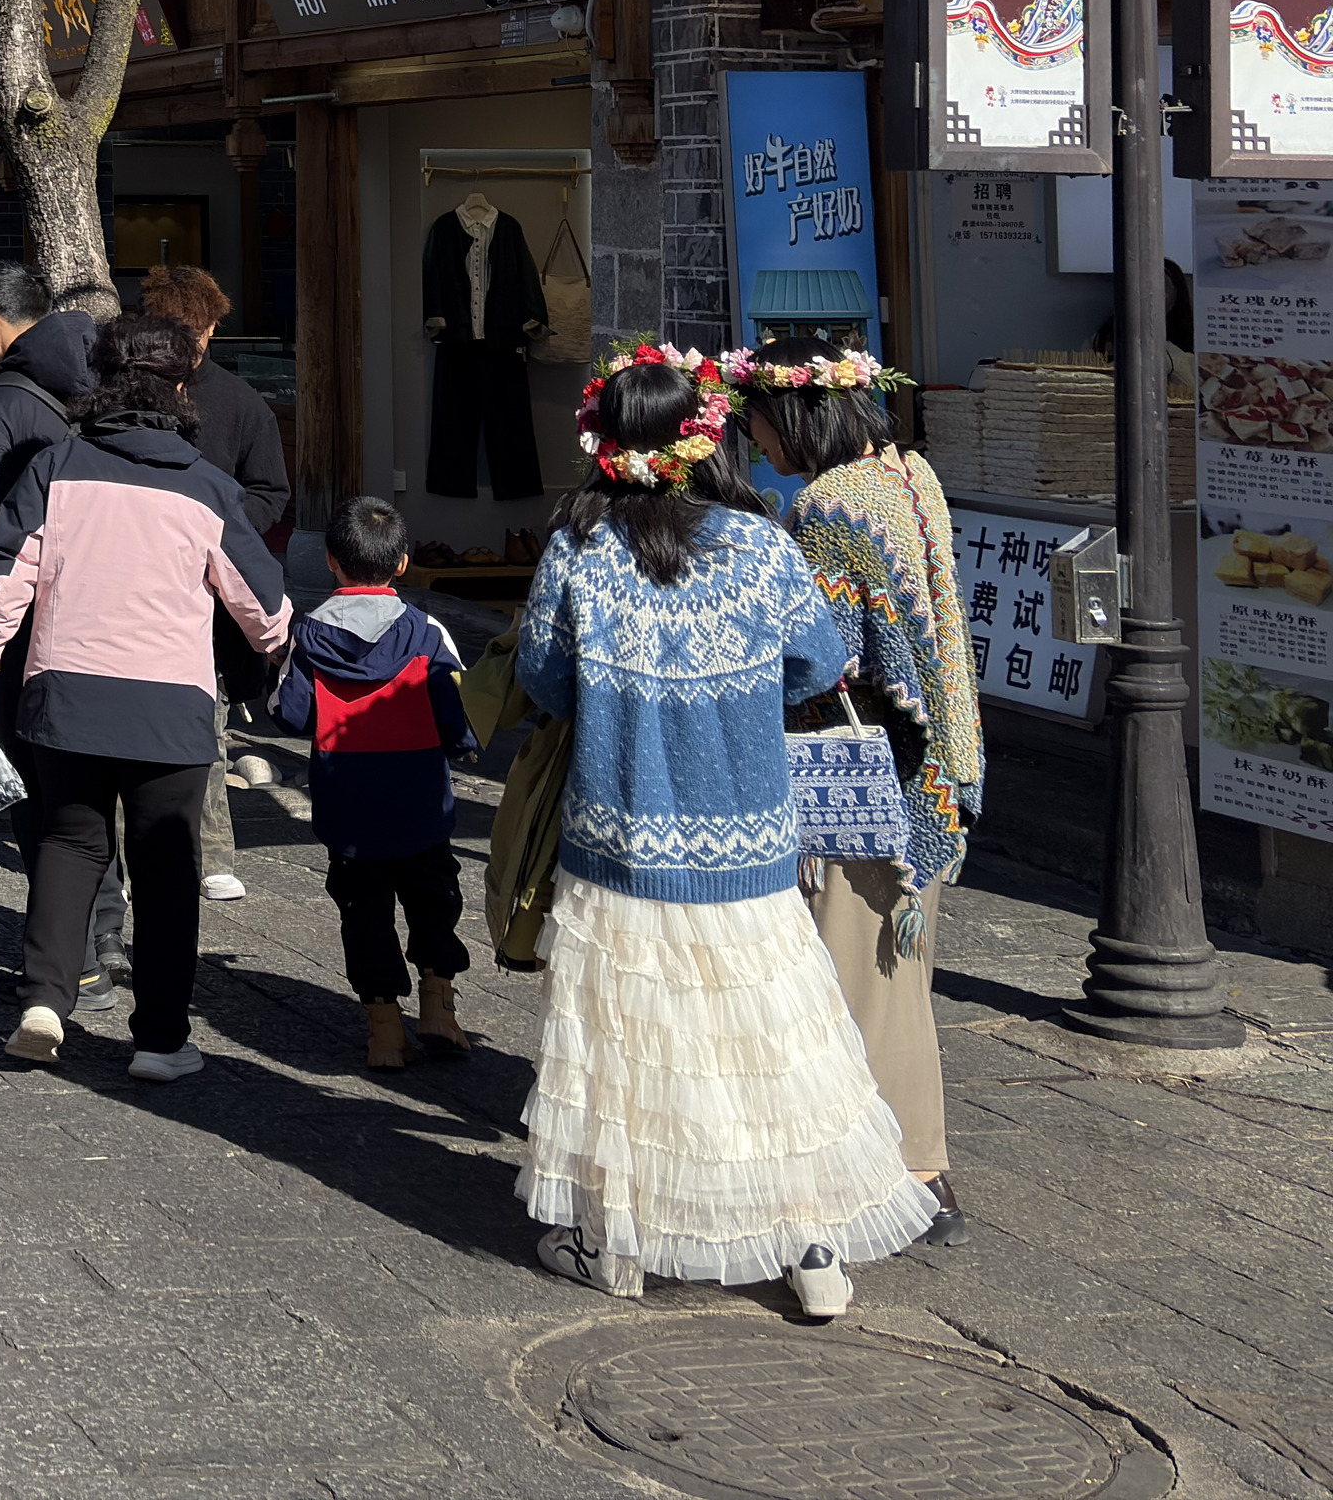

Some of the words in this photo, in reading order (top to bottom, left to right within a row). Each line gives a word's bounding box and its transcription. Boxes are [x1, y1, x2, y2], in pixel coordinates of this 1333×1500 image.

[743, 133, 837, 196] 好牛自然
[974, 182, 1012, 200] 招聘
[787, 186, 863, 246] 产好奶
[1219, 294, 1318, 308] 玫瑰奶酥
[1218, 447, 1318, 468] 草莓奶酥
[1233, 604, 1318, 628] 原味奶酥
[1233, 757, 1328, 790] 抹茶奶酥
